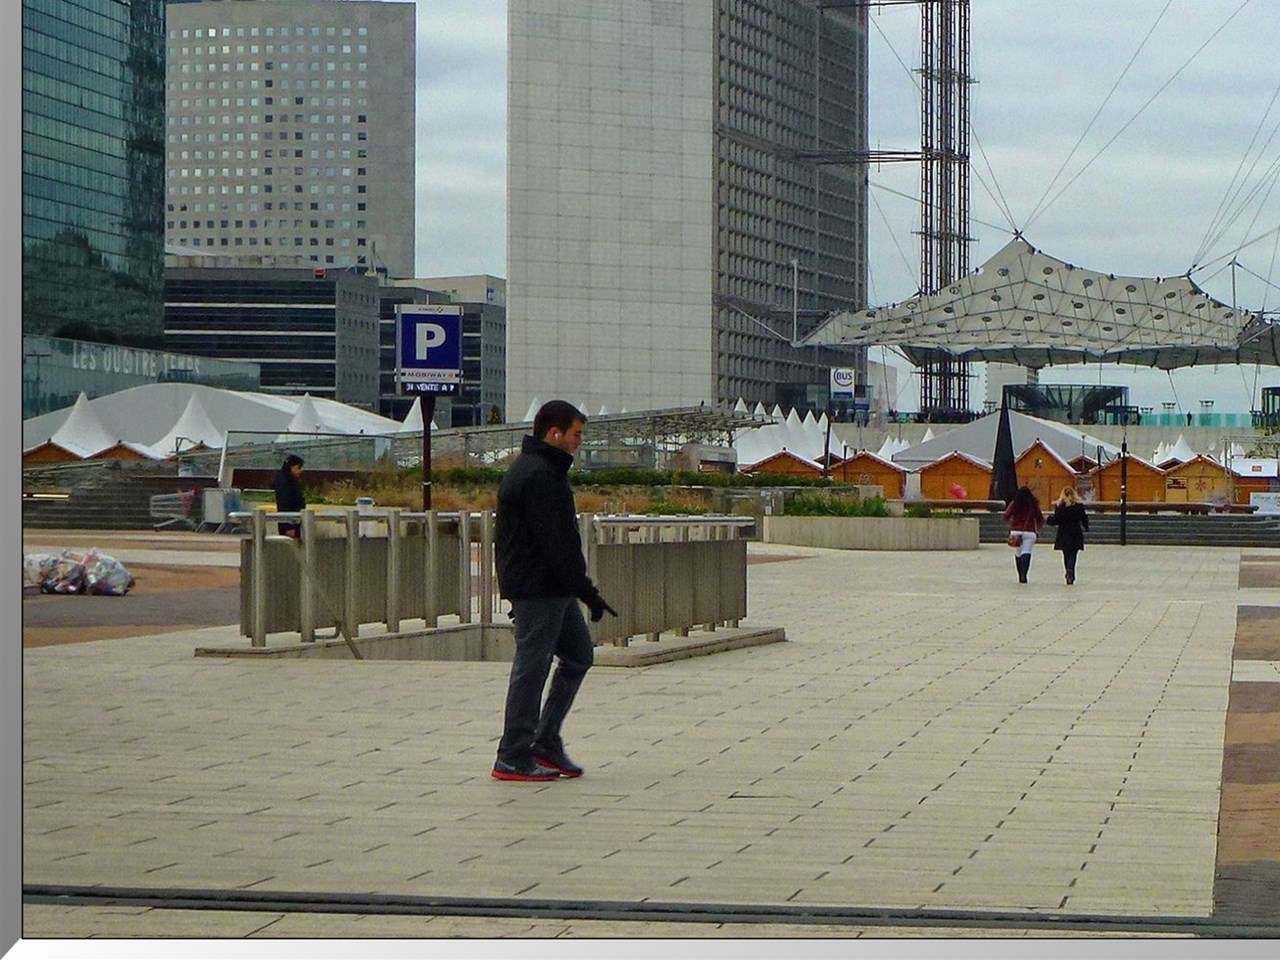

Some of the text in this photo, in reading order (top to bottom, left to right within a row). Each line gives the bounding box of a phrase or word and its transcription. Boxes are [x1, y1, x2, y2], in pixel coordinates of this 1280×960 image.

[72, 340, 96, 370] LES
[103, 346, 157, 377] QUATRE
[416, 323, 446, 360] P
[836, 371, 852, 380] BUS
